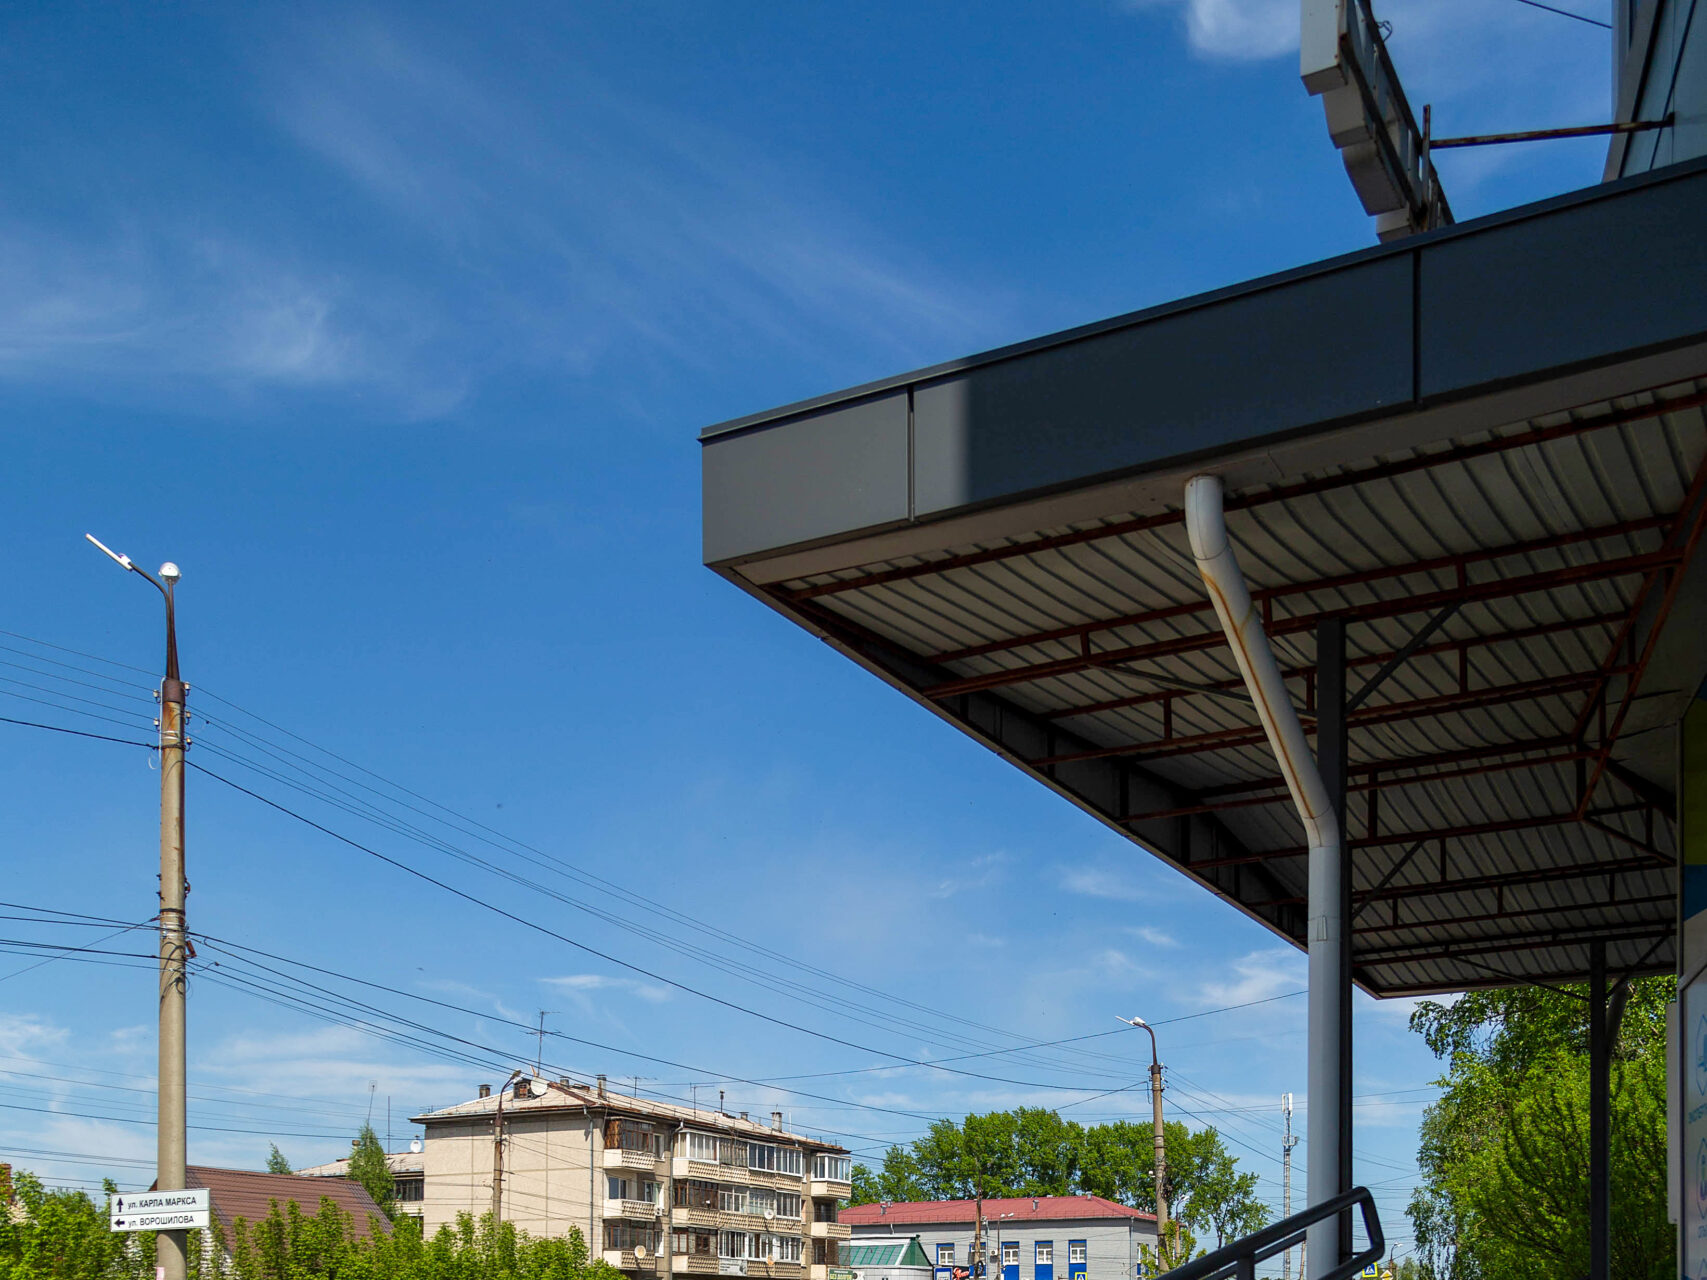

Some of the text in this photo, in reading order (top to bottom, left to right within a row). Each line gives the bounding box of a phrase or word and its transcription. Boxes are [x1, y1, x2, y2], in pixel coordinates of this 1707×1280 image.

[139, 1199, 163, 1207] КАРЛА
[165, 1196, 196, 1206] МАРКСА
[127, 1215, 194, 1228] ул. ВОРОШИЛОВА
